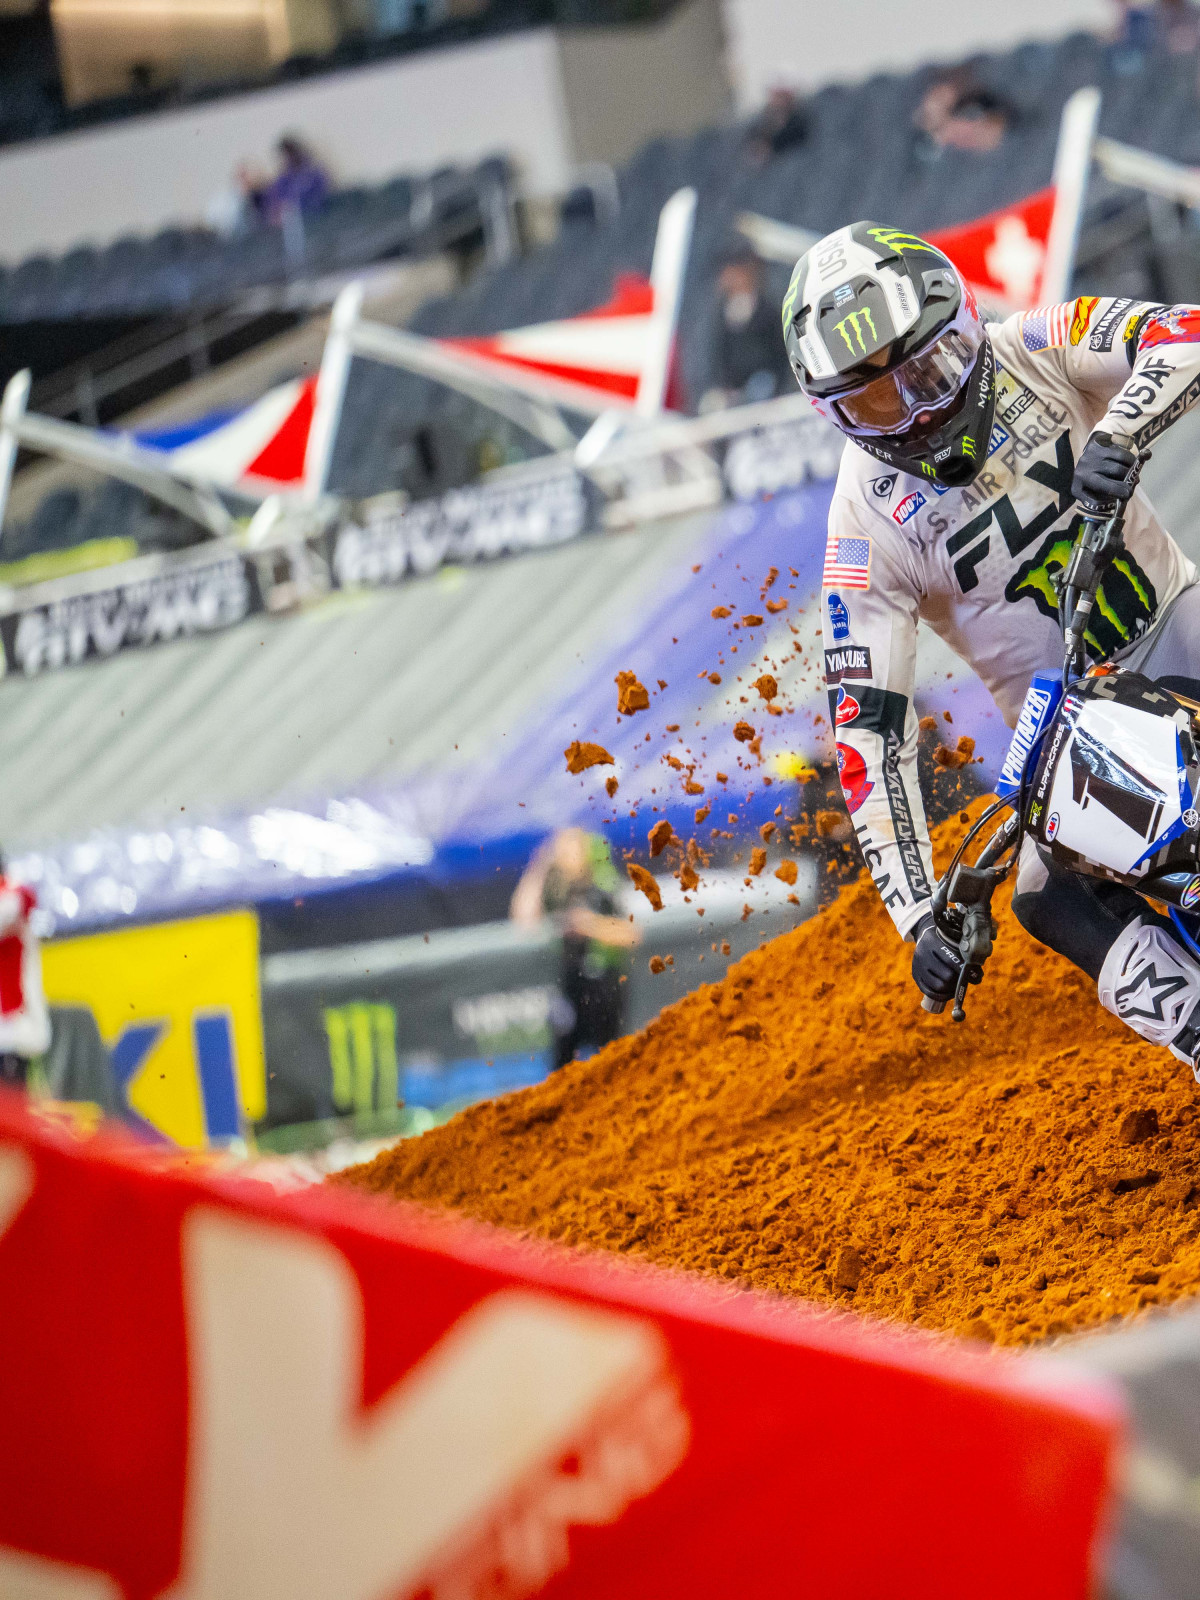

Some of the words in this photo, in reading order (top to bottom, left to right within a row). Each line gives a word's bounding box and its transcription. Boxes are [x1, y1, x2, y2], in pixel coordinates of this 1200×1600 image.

[1109, 356, 1177, 420] USAF
[934, 446, 952, 463] FLY
[961, 471, 1005, 512] AIR
[1000, 401, 1067, 475] FORCE
[893, 494, 924, 522] 100%
[946, 428, 1076, 593] FLY
[1000, 687, 1049, 787] PROTAPER
[1037, 723, 1065, 800] SUPERCROSS
[1069, 724, 1168, 845] 1
[940, 945, 960, 965] PRO
